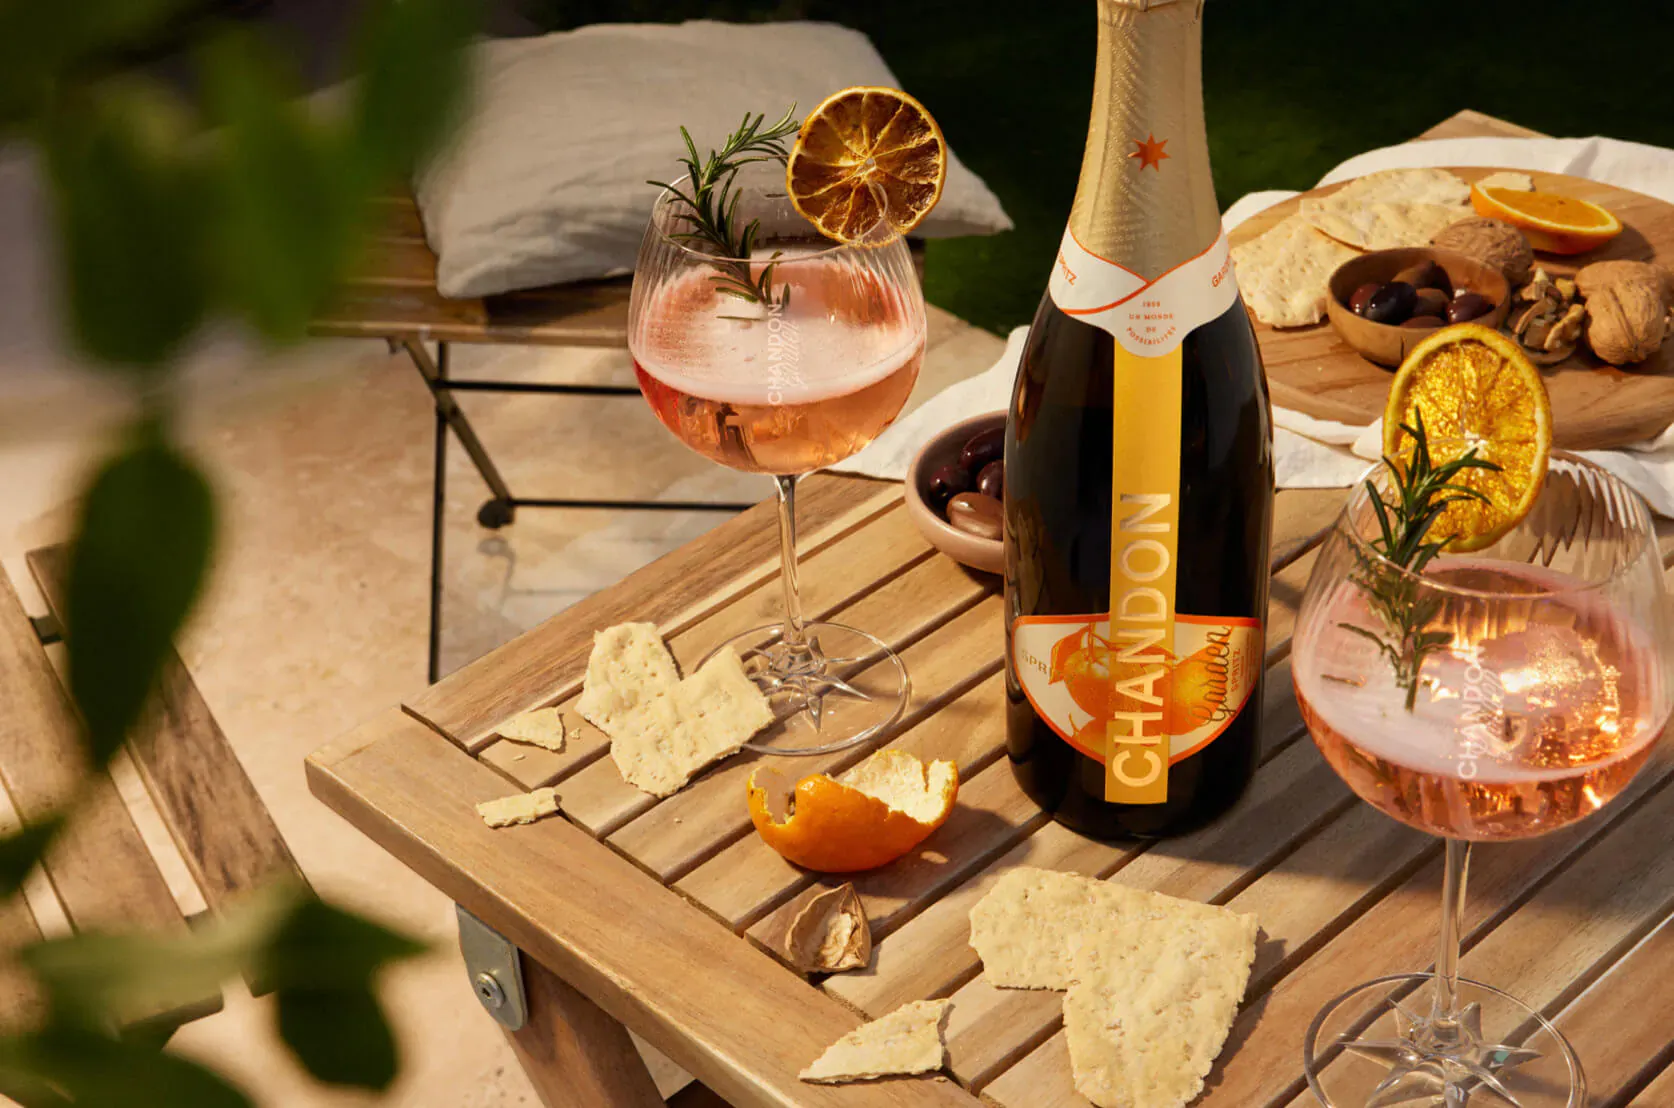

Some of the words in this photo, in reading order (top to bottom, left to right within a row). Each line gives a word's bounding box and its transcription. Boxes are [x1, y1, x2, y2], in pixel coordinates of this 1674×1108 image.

[767, 303, 783, 406] CHANDON
[1111, 493, 1171, 788] CHANDON
[1185, 625, 1238, 727] Garden
